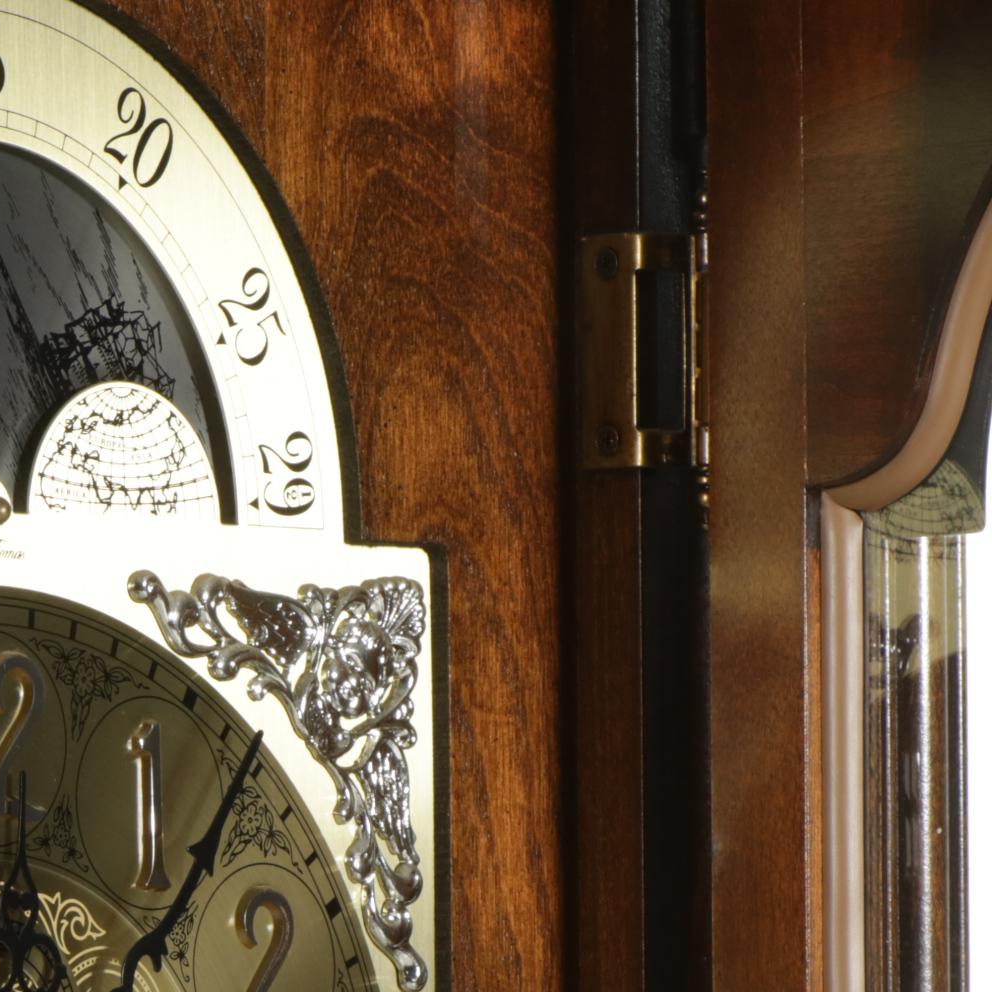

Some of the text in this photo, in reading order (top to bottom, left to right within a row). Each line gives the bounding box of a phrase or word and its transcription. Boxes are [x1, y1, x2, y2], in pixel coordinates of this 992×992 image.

[103, 86, 174, 188] 20
[217, 266, 287, 367] 25
[55, 487, 87, 499] AFRICA
[257, 430, 316, 517] 29
[125, 718, 172, 893] 1
